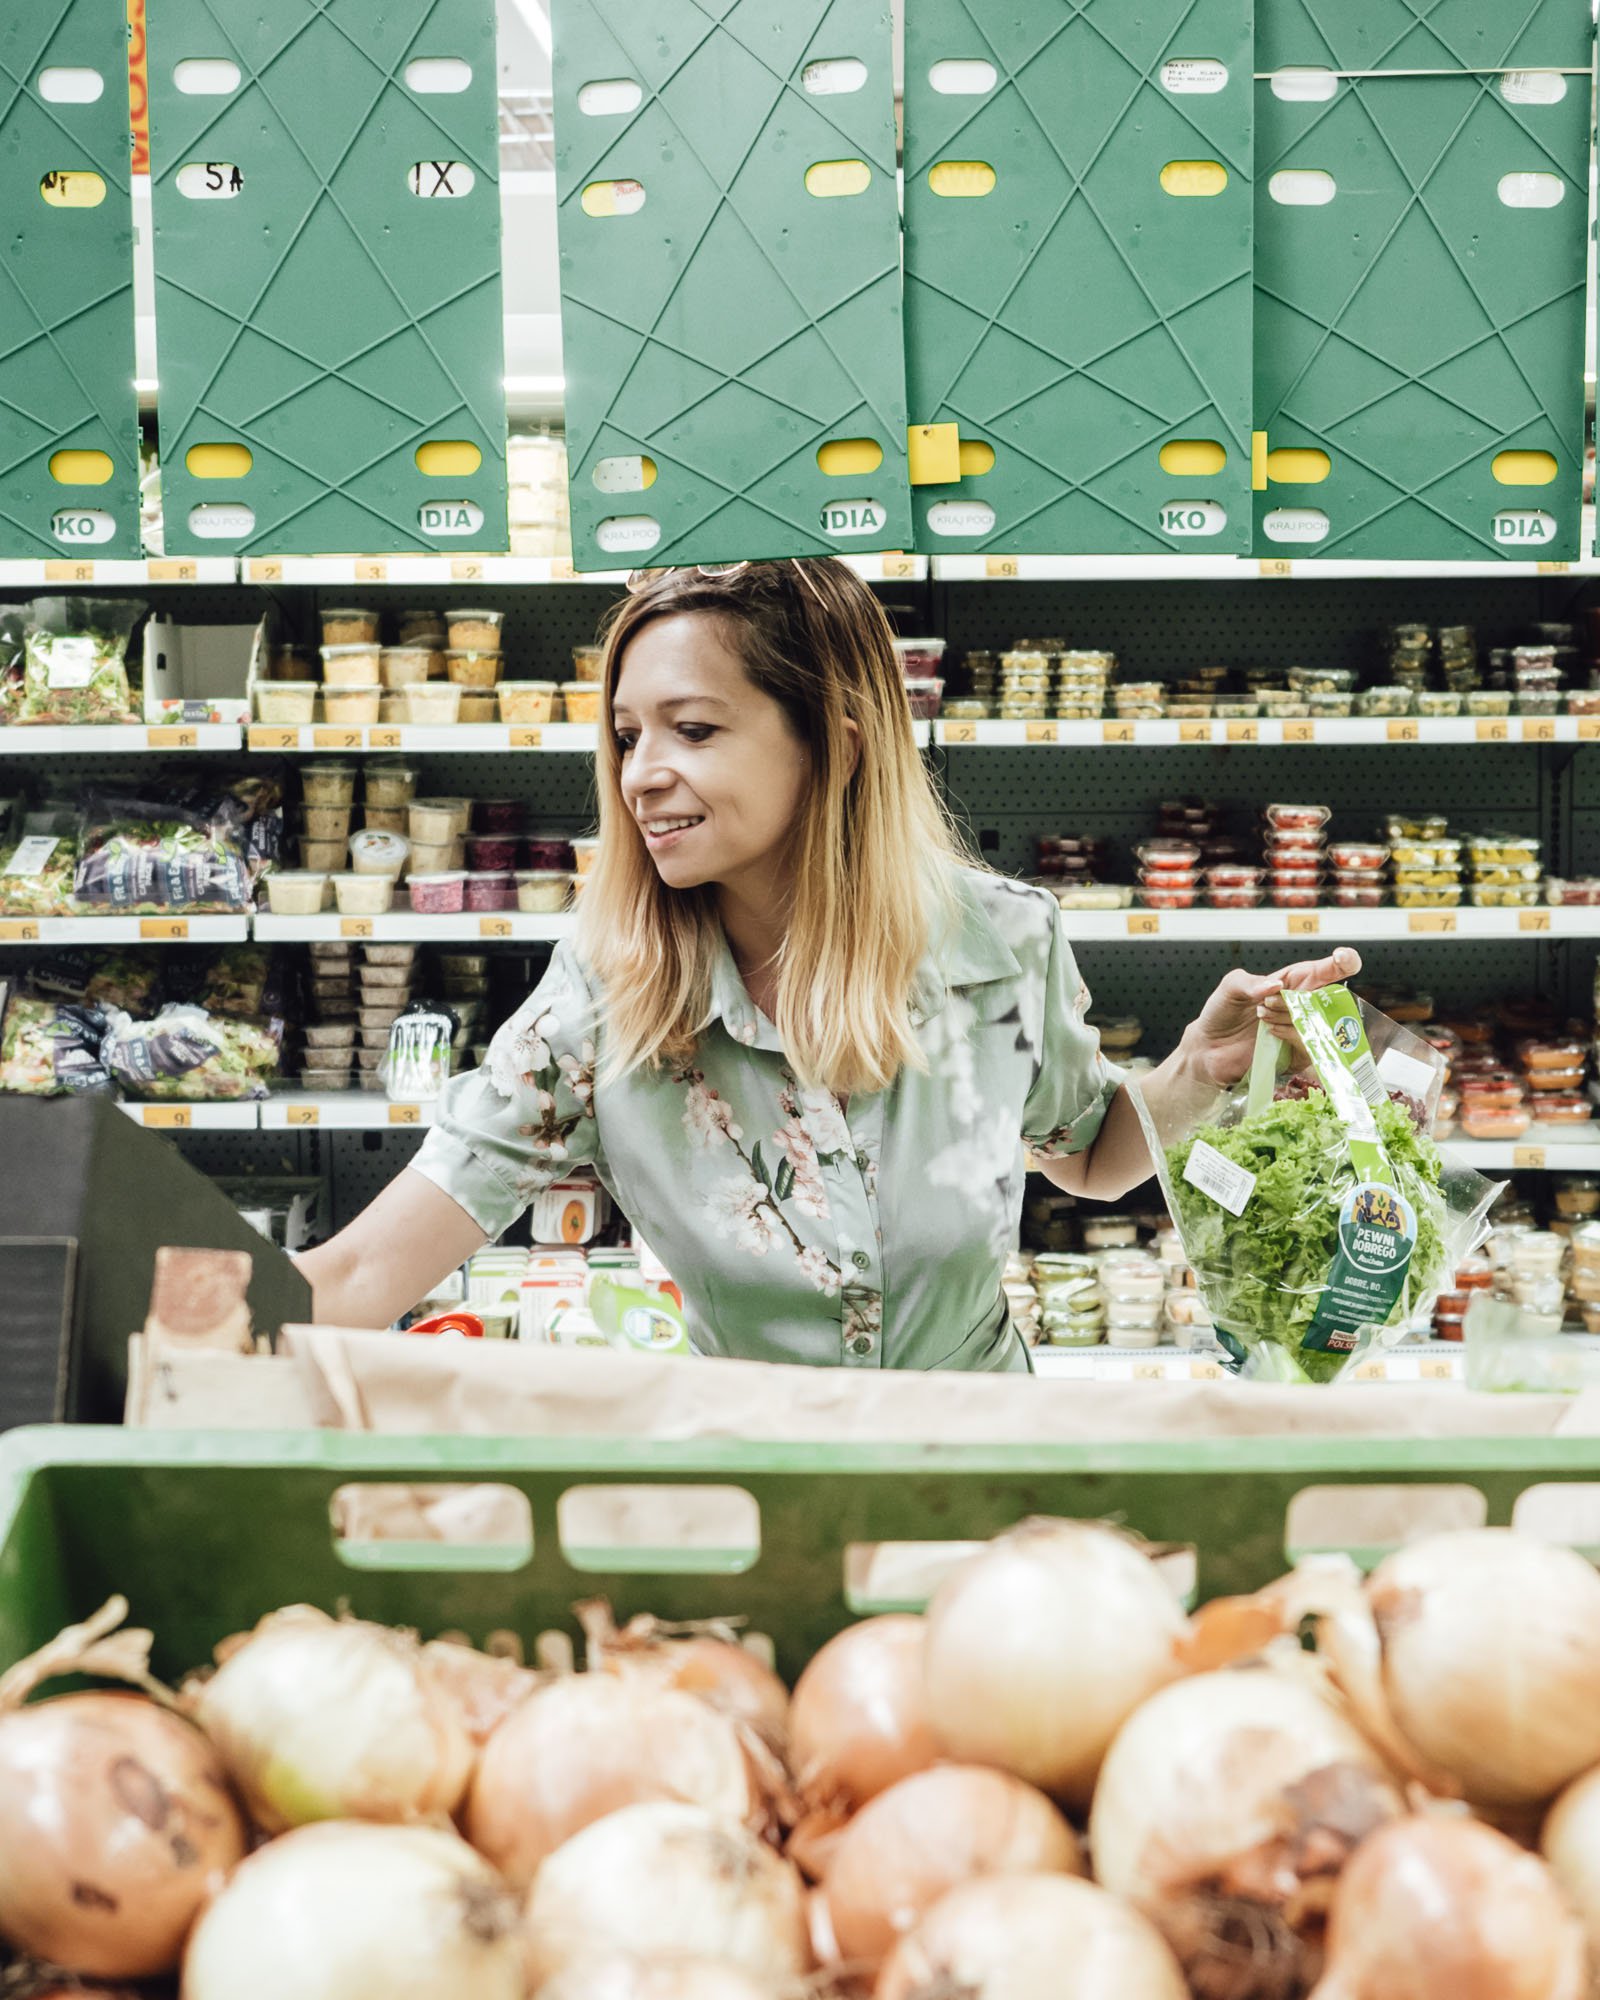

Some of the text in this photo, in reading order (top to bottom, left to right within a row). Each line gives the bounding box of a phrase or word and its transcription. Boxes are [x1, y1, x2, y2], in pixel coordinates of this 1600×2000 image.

[417, 509, 472, 528] DIA
[1269, 520, 1296, 531] KRAJ
[179, 566, 190, 579] 8
[264, 567, 275, 580] 2
[369, 566, 380, 580] 3
[466, 566, 477, 580] 2
[897, 563, 908, 577] 2
[1001, 563, 1011, 577] 9
[1274, 562, 1284, 575] 9
[959, 728, 970, 741] 2
[1040, 729, 1051, 741] 4
[1117, 729, 1128, 741] 4
[1195, 728, 1205, 741] 4
[1241, 728, 1251, 741] 4
[1297, 727, 1307, 740] 3
[1401, 727, 1412, 740] 6
[1490, 725, 1501, 739] 6
[1537, 725, 1548, 739] 6
[178, 734, 189, 747] 8
[281, 735, 292, 747] 2
[345, 735, 355, 747] 2
[384, 734, 394, 747] 3
[524, 734, 534, 747] 3
[172, 887, 185, 900] Fit
[494, 923, 505, 937] 3
[1142, 920, 1153, 934] 9
[1302, 920, 1313, 934] 9
[1439, 918, 1450, 931] 7
[1534, 917, 1545, 930] 7
[22, 927, 32, 940] 6
[171, 926, 182, 938] 9
[355, 924, 366, 937] 3
[174, 1112, 184, 1125] 9
[302, 1112, 313, 1124] 2
[403, 1111, 413, 1123] 3
[1356, 1227, 1396, 1247] PEWNI
[1352, 1238, 1397, 1259] DOBREGO
[1357, 1253, 1385, 1267] Auchan
[1327, 1338, 1359, 1351] POLSK
[1205, 1367, 1217, 1379] 9
